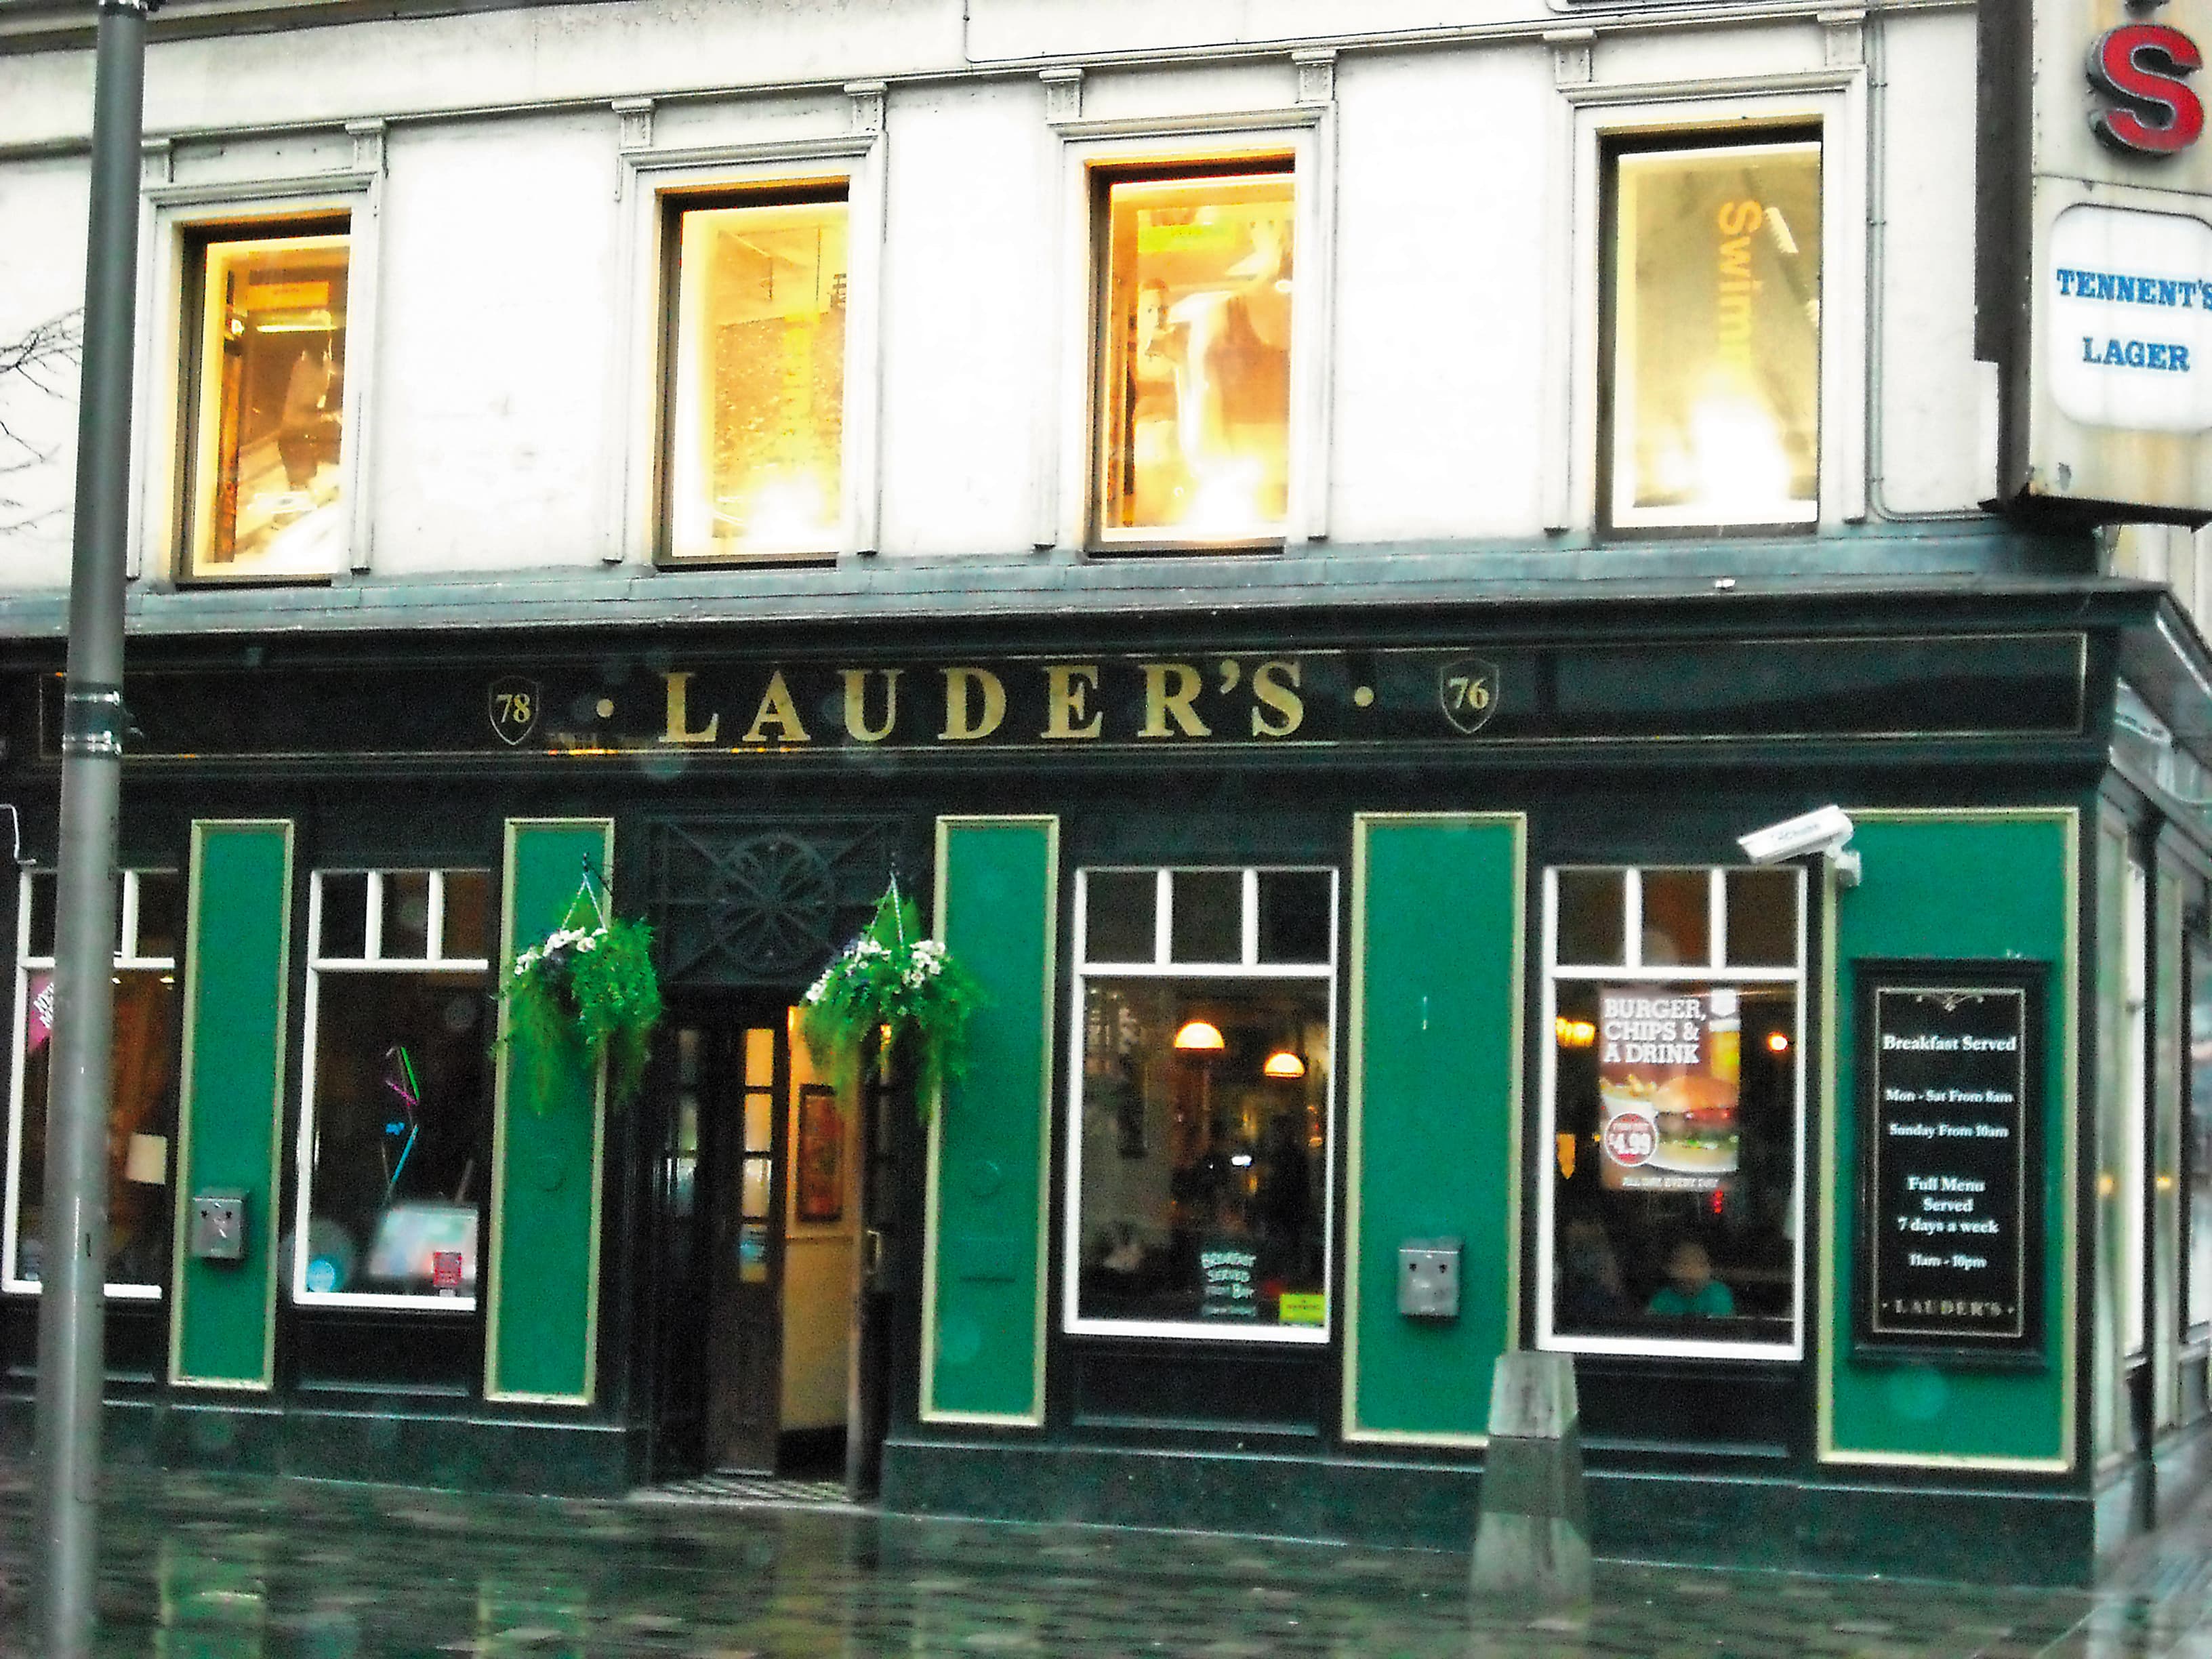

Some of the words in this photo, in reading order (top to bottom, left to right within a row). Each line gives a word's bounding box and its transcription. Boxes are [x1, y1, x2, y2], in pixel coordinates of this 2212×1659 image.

[2098, 22, 2205, 156] S
[1718, 200, 1763, 361] Swim
[2056, 268, 2212, 312] TENNENT'S
[2082, 337, 2190, 373] LAGER
[658, 659, 1305, 743] LAUDER'S
[1448, 678, 1490, 710] 76
[495, 693, 531, 724] 78
[1603, 998, 1706, 1022] BURGER,
[1604, 1020, 1677, 1042] CHIPS
[1683, 1021, 1700, 1042] &
[1883, 1033, 1959, 1050] Breakfast
[1963, 1034, 2018, 1051] Served
[1603, 1042, 1621, 1063] A
[1625, 1043, 1700, 1064] DRINK
[1886, 1088, 1917, 1102] Mon
[1926, 1089, 1946, 1103] Sat
[1948, 1090, 1983, 1103] From
[1985, 1090, 2014, 1103] 8am
[1889, 1123, 1936, 1139] Sunday
[1938, 1124, 1973, 1137] From
[1975, 1124, 2010, 1138] 10am
[1908, 1176, 1939, 1191] Full
[1941, 1177, 1986, 1192] Menu
[1923, 1197, 1973, 1212] Served
[1898, 1216, 1908, 1231] 7
[1910, 1217, 1944, 1236] days
[1947, 1222, 1957, 1233] a
[1959, 1220, 2000, 1234] week
[1908, 1253, 1942, 1267] 11am
[1952, 1254, 1988, 1271] 10pm
